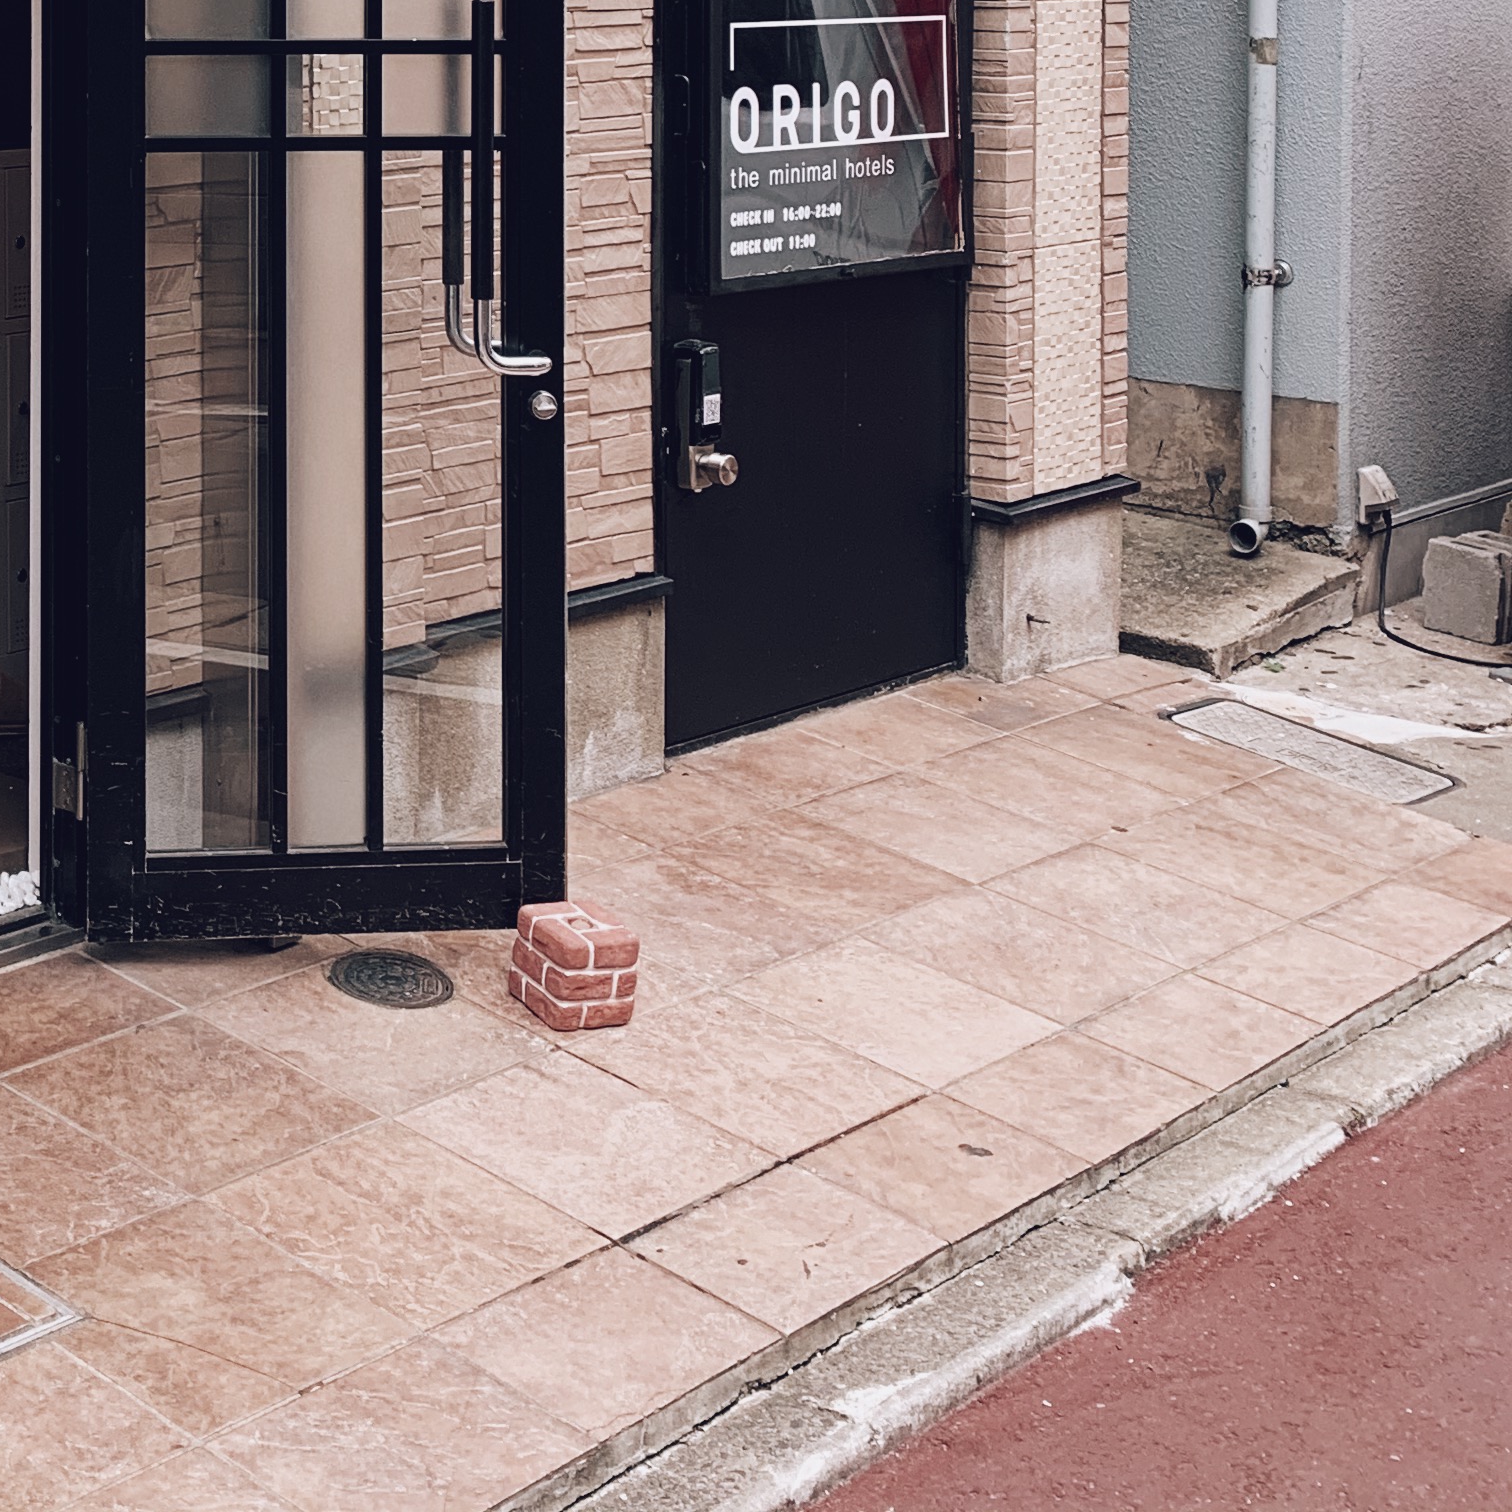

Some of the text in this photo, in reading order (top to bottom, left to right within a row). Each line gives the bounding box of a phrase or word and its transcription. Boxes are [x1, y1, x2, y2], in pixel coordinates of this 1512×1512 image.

[729, 78, 895, 154] ORIGO
[730, 154, 895, 190] the minimal hotels
[730, 210, 762, 228] CHECK
[763, 208, 775, 224] IN
[730, 233, 816, 257] CHECK OUT 11:00
